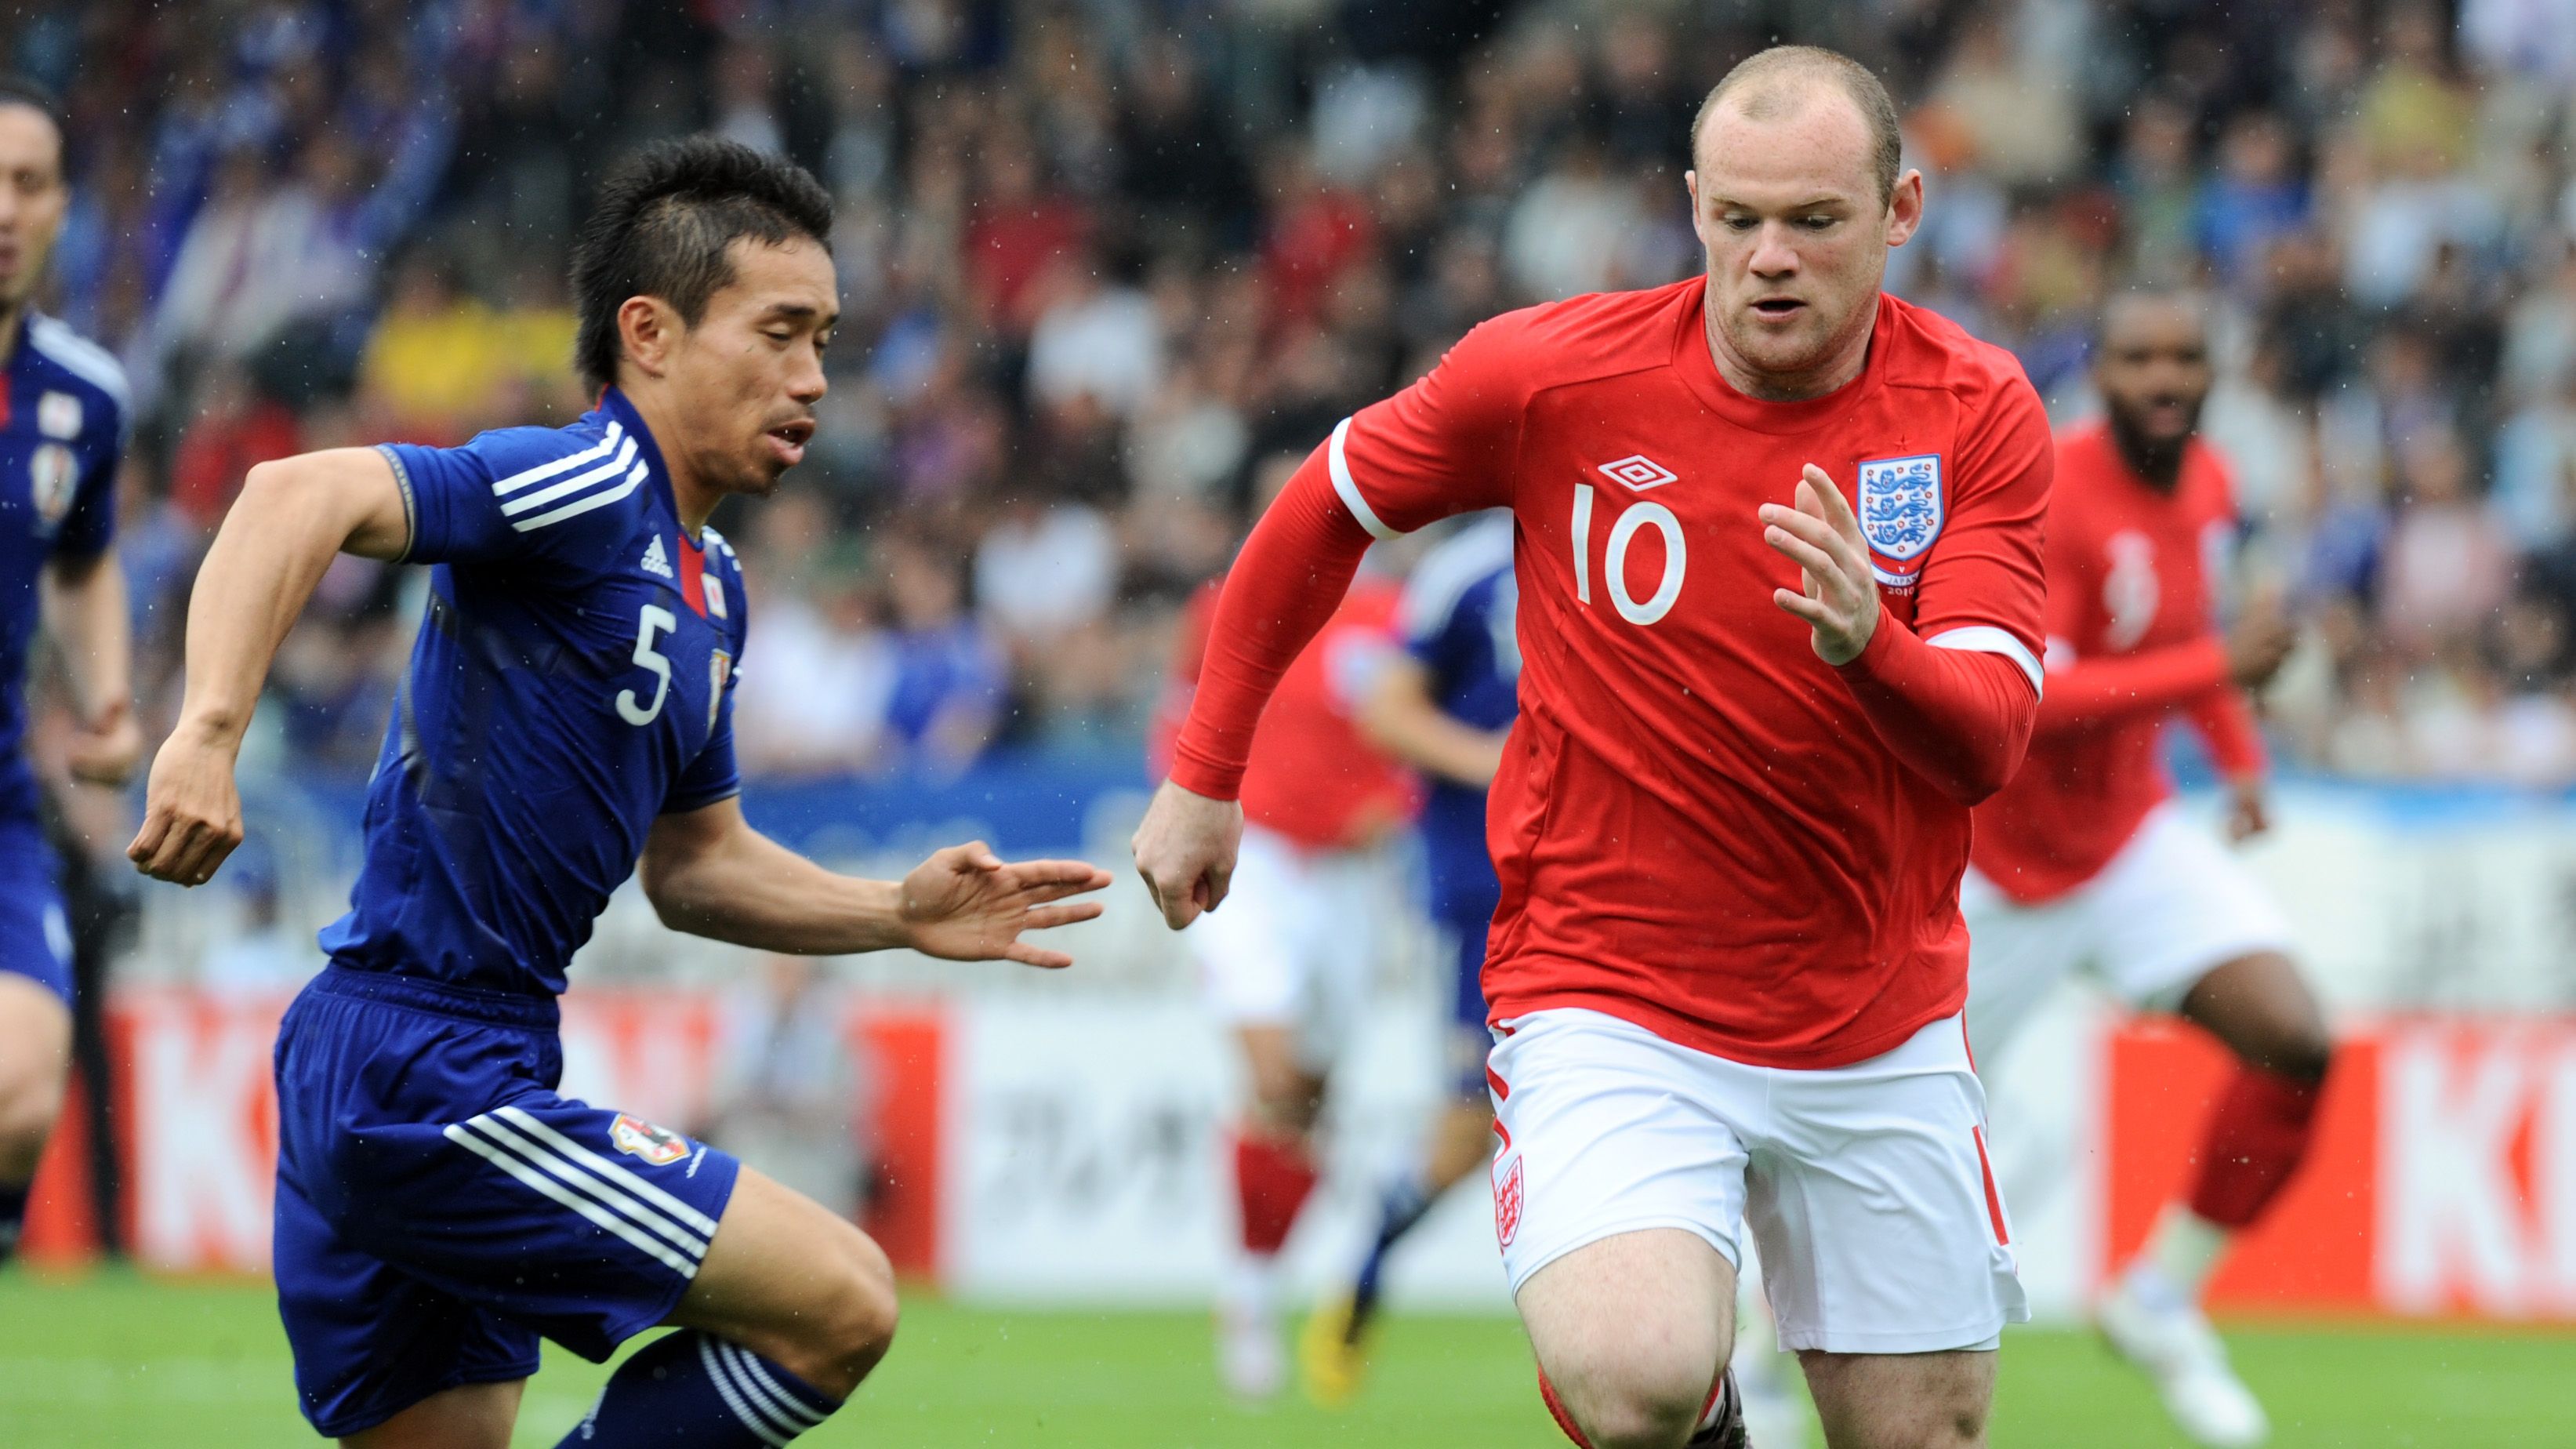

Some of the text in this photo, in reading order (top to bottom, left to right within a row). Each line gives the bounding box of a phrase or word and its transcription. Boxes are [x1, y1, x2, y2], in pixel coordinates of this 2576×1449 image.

[1571, 482, 1687, 625] 10
[1888, 586, 1914, 597] 2010
[616, 604, 676, 726] 5
